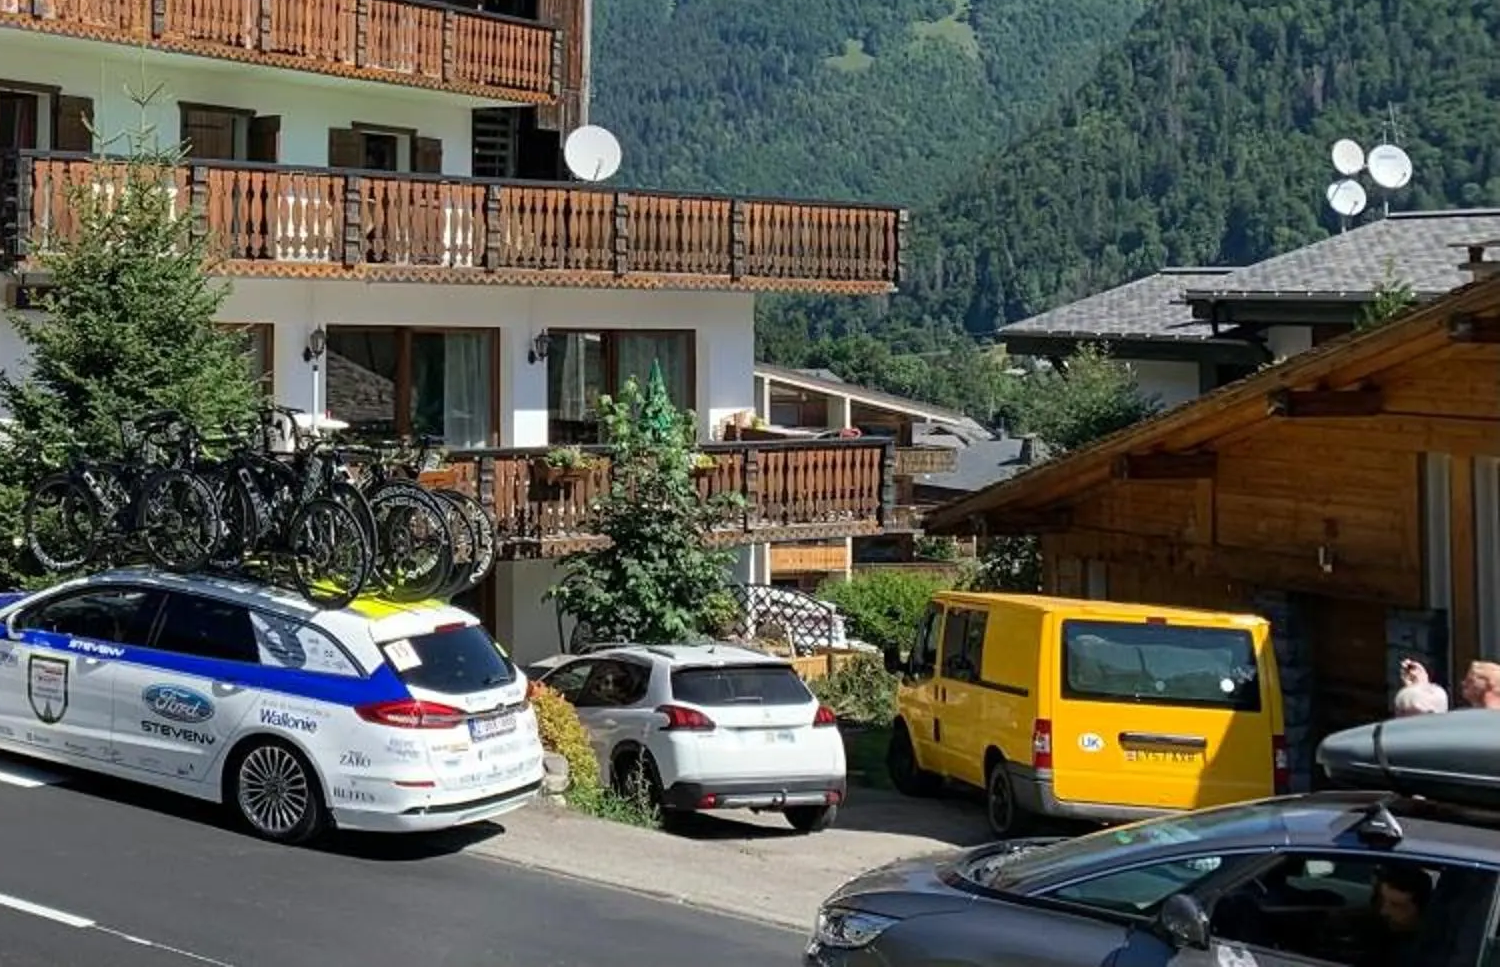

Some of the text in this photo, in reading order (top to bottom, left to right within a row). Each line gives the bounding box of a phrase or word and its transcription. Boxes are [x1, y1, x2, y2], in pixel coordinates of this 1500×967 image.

[154, 688, 202, 719] Ford
[141, 720, 216, 745] STEVENY
[260, 708, 317, 733] Wallonie
[1082, 737, 1099, 748] UK
